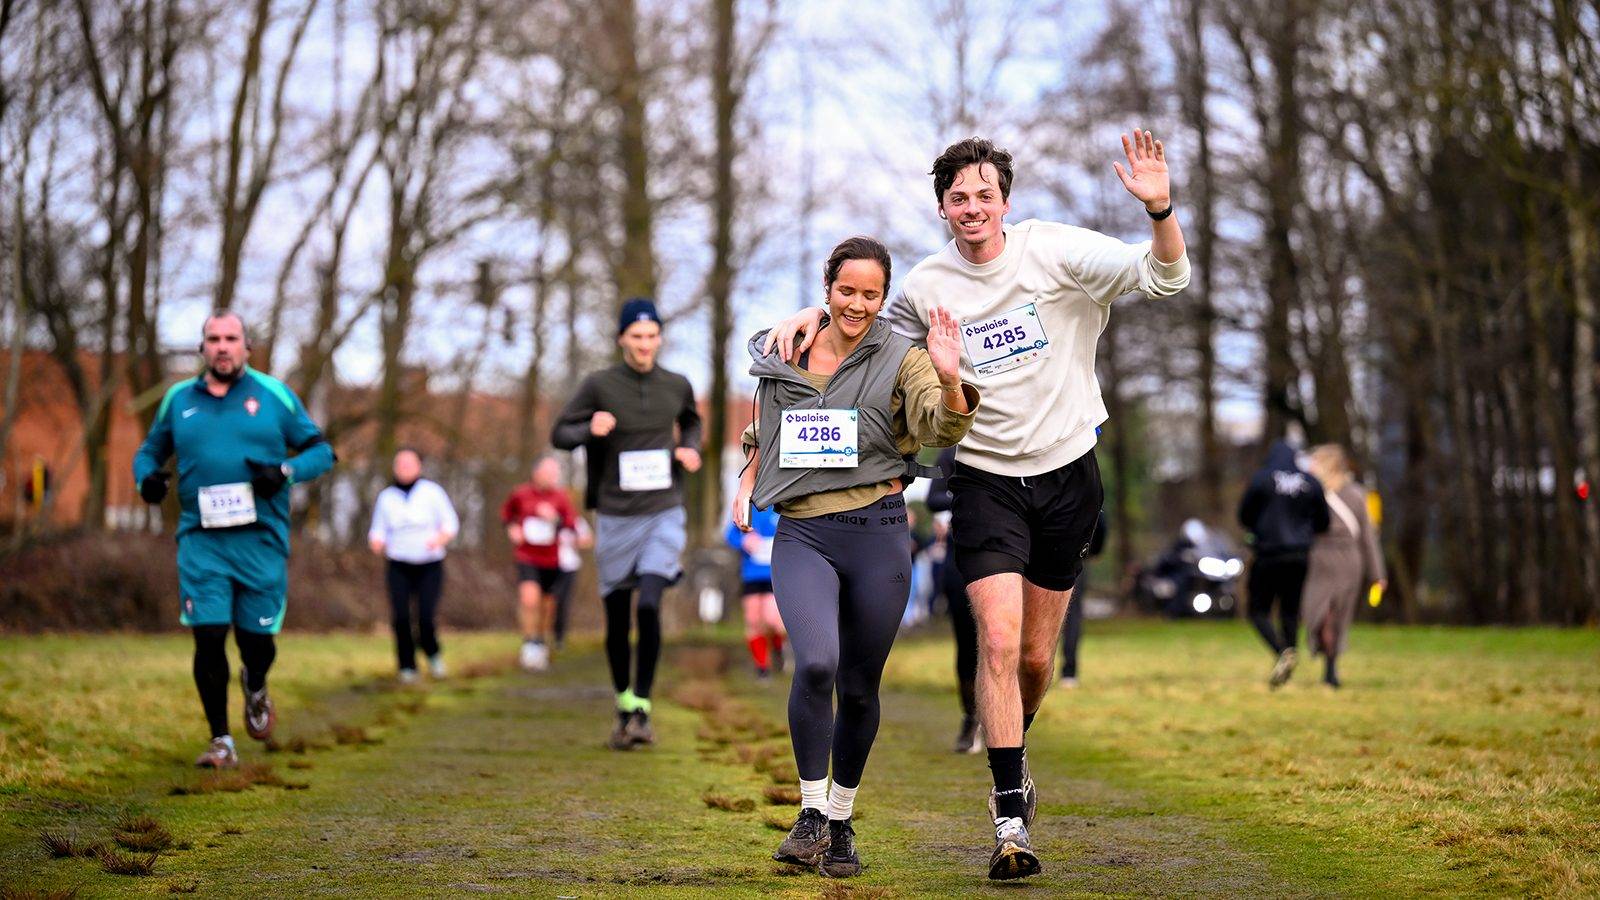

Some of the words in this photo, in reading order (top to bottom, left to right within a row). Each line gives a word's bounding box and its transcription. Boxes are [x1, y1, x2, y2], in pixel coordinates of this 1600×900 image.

[973, 318, 1009, 334] baloise
[983, 325, 1026, 350] 4285
[795, 412, 830, 422] baloise
[797, 426, 841, 441] 4286
